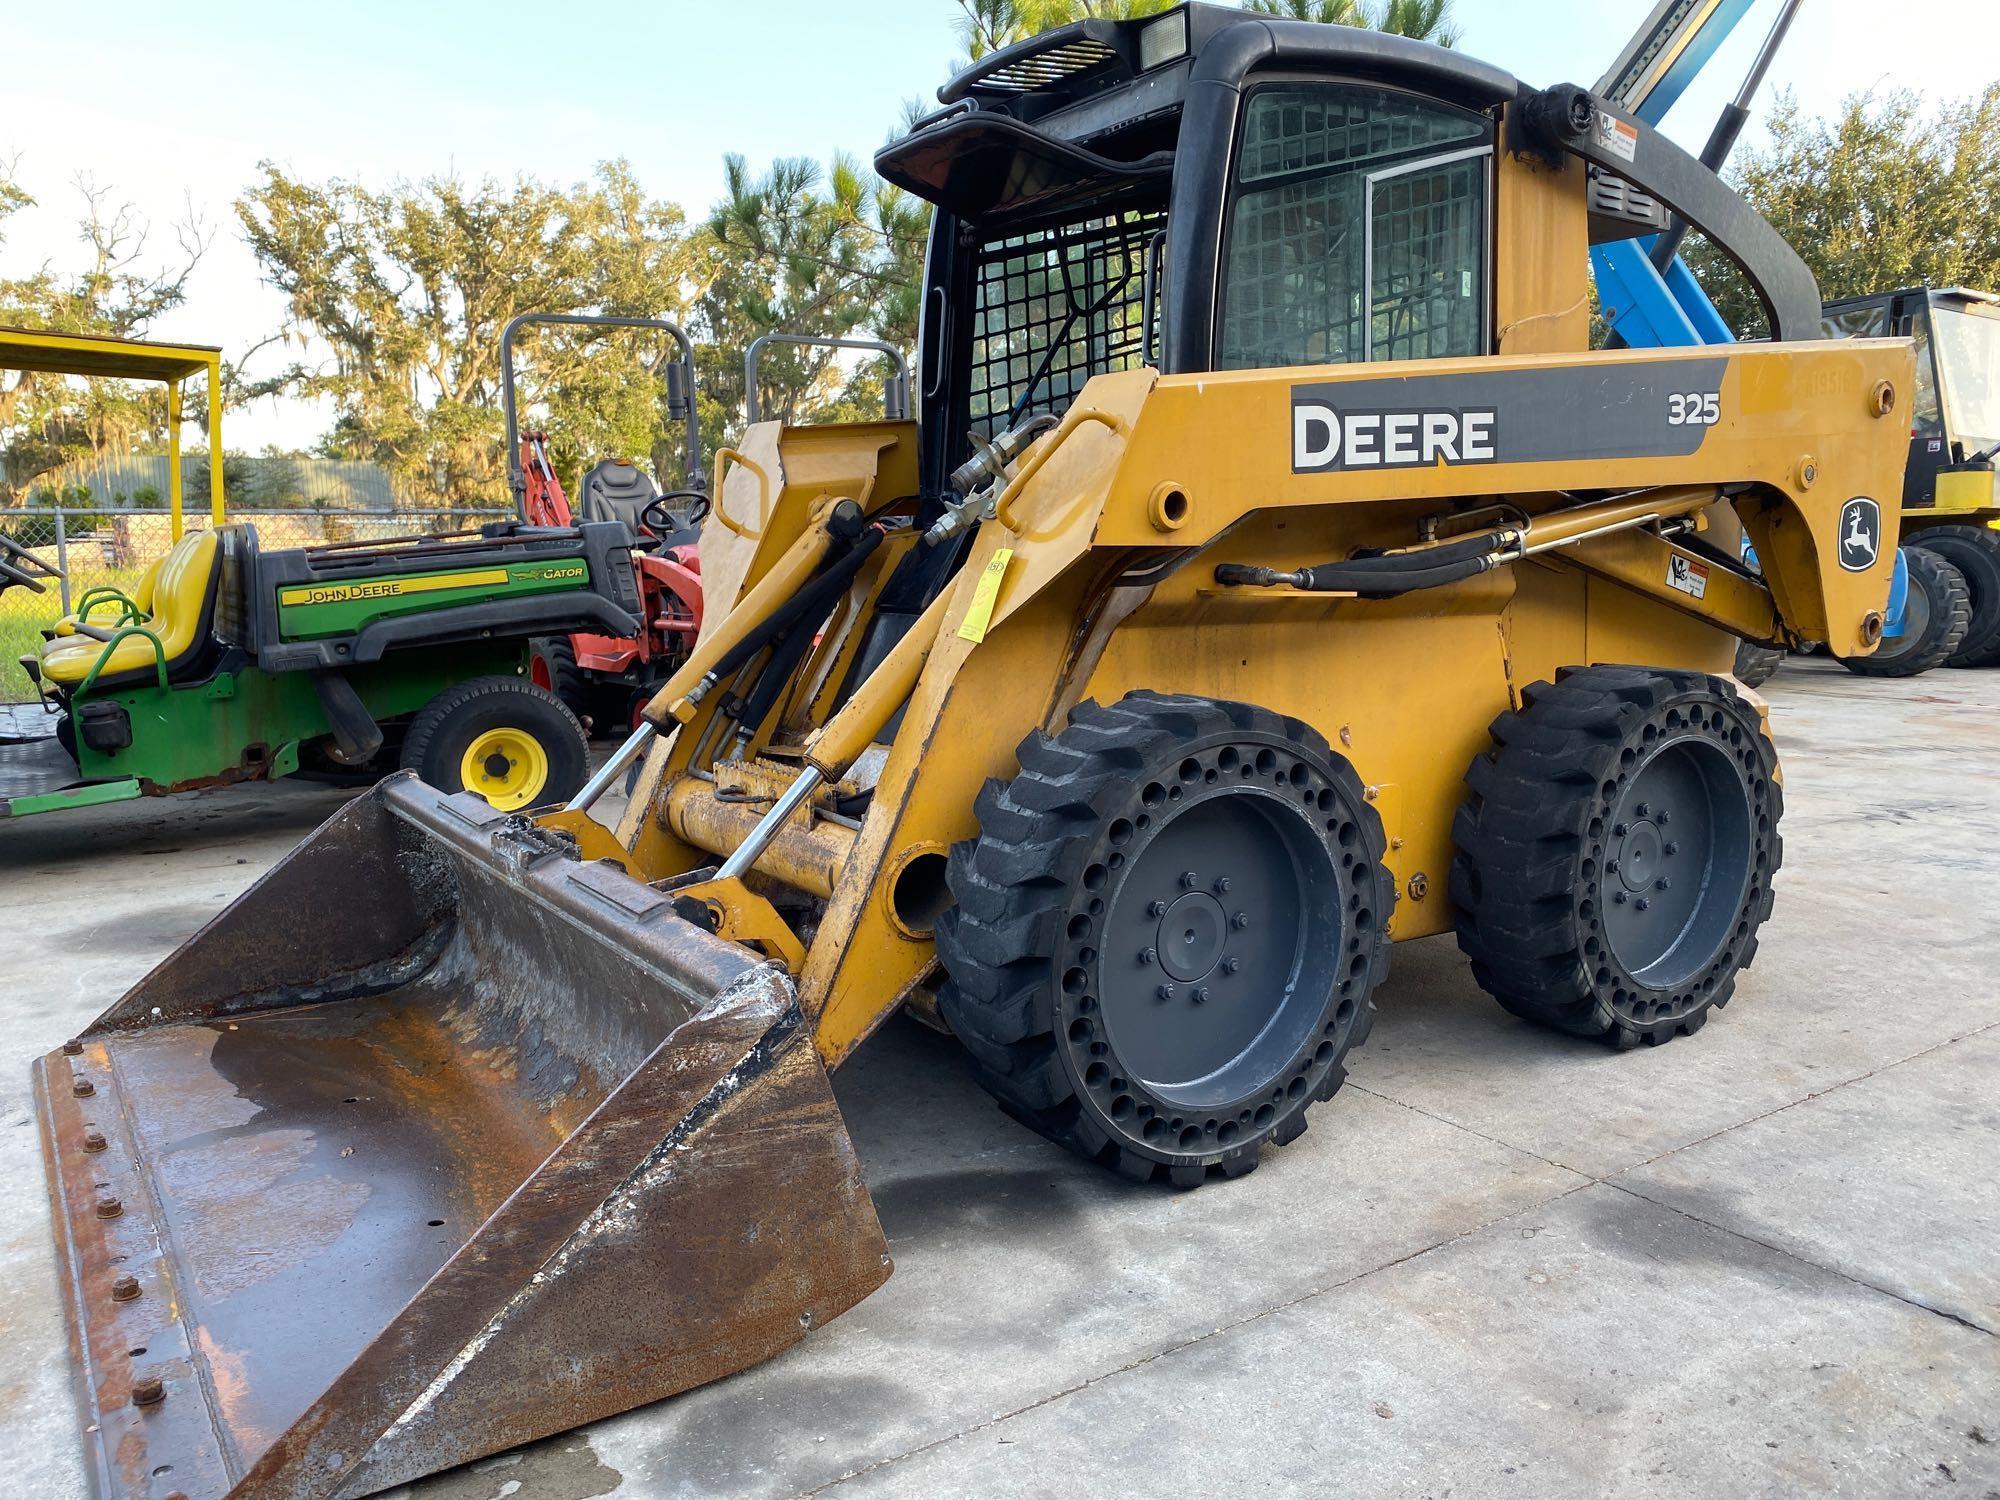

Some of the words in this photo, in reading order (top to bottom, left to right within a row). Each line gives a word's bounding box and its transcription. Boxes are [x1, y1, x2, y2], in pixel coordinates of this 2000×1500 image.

[1668, 393, 1720, 425] 325
[1294, 405, 1494, 467] DEERE
[544, 567, 583, 579] GATOR
[305, 589, 347, 603] JOHN
[350, 584, 400, 598] DEERE
